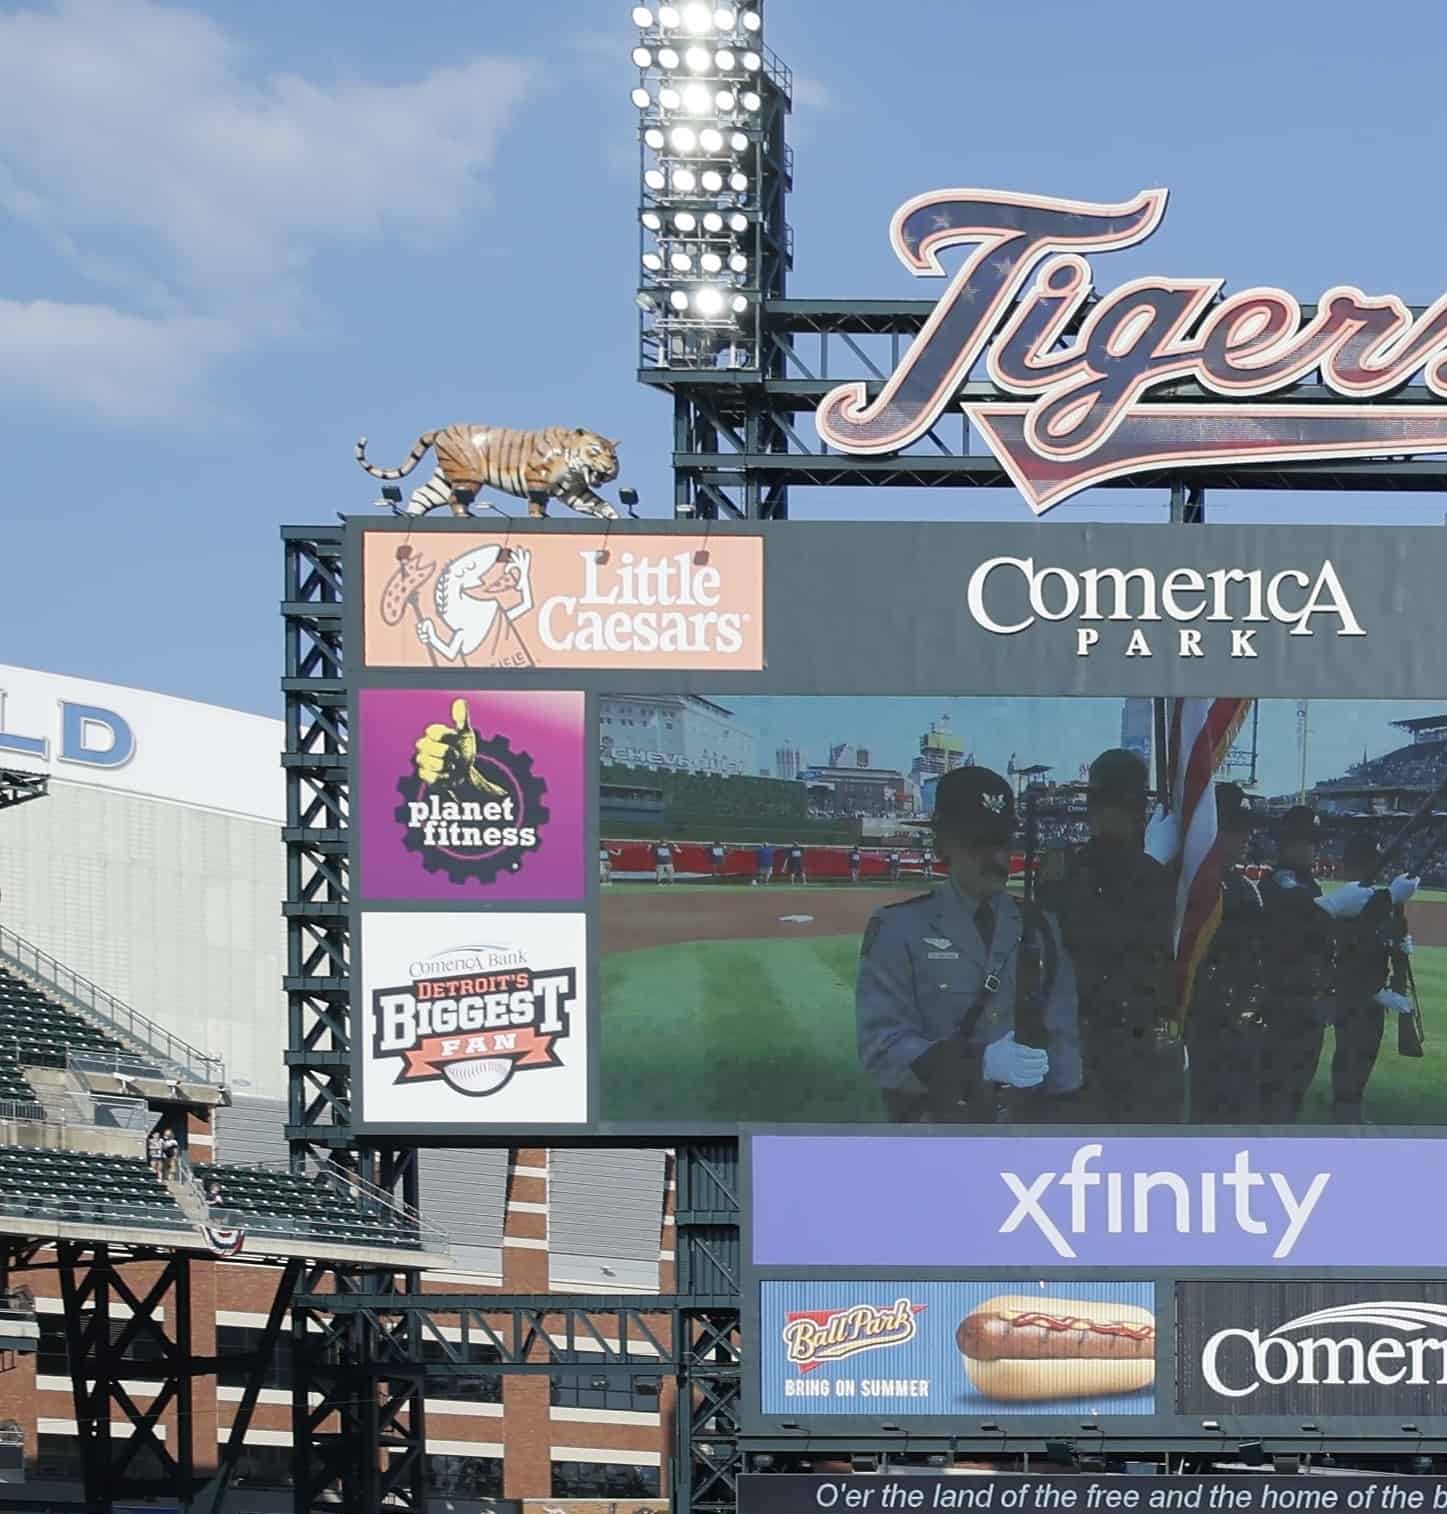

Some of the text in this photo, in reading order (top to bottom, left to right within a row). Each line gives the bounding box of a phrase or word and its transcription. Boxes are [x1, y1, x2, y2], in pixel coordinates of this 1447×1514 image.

[580, 551, 720, 604] Little
[538, 597, 745, 653] Caesars
[1076, 628, 1257, 657] PARK
[408, 795, 514, 828] planet
[423, 820, 537, 847] fitness
[489, 950, 528, 968] Bank
[416, 973, 529, 999] DETROIT'S
[379, 976, 570, 1051] BIGGEST
[441, 1033, 516, 1056] FAN
[998, 1144, 1332, 1258] xfinity
[784, 1299, 913, 1362] Ball Park
[784, 1379, 929, 1397] BRING ON SUMMER
[816, 1484, 874, 1508] O'er
[881, 1484, 924, 1508] the
[933, 1484, 993, 1508] land
[1001, 1484, 1033, 1508] of
[1035, 1484, 1078, 1508] the
[1086, 1484, 1139, 1508] free
[1150, 1484, 1202, 1508] and
[1209, 1484, 1252, 1508] the
[1261, 1484, 1338, 1508] home
[1347, 1484, 1376, 1508] of
[1381, 1484, 1424, 1508] the
